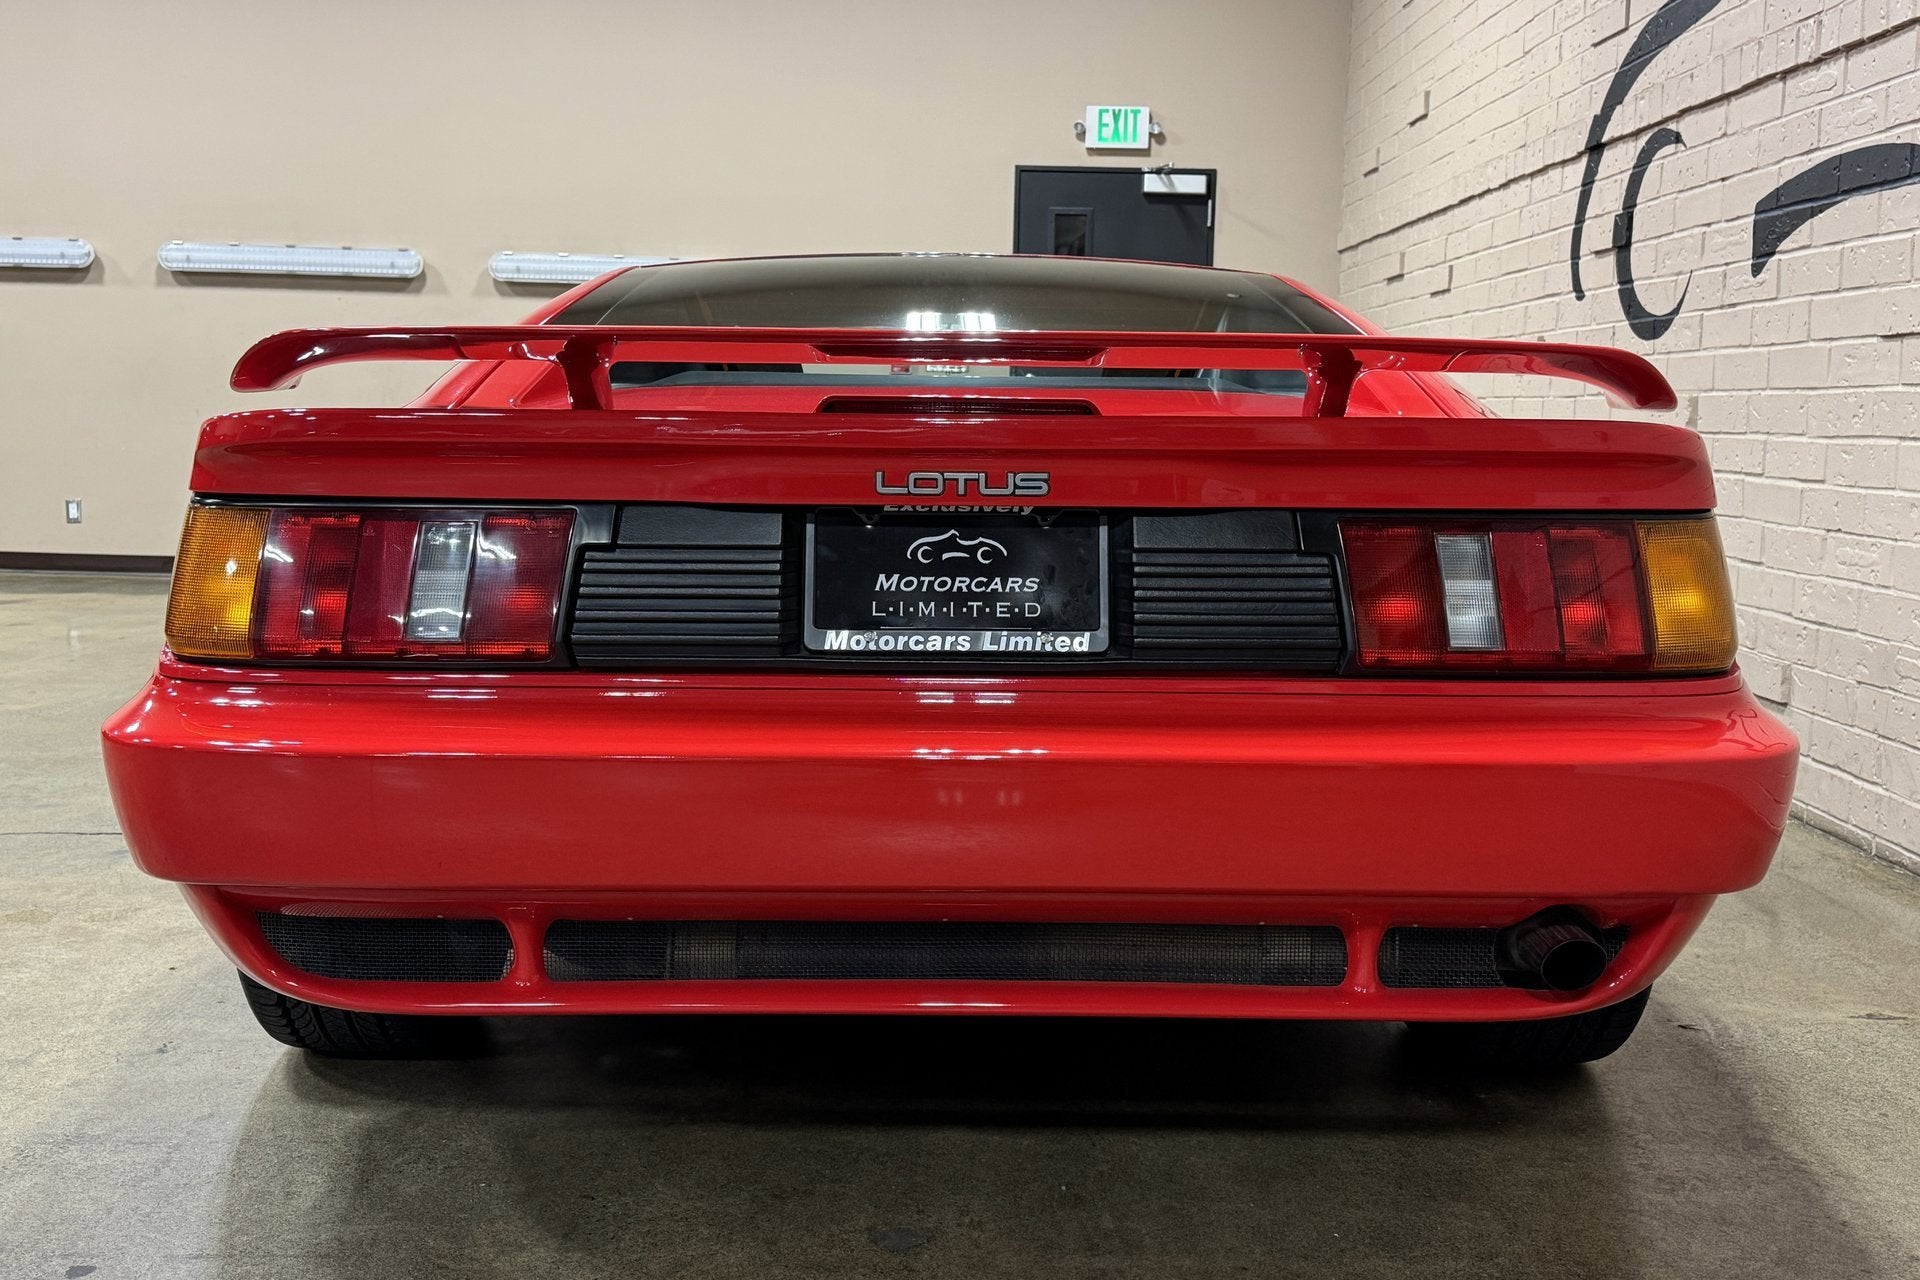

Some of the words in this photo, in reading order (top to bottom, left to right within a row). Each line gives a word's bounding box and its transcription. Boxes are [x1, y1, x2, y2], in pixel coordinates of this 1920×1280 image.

[1098, 108, 1141, 143] EXIT
[875, 471, 1050, 496] LOTUS
[874, 573, 1040, 593] MOTORCARS
[823, 629, 972, 652] Motorcars
[982, 631, 1091, 652] Limited
